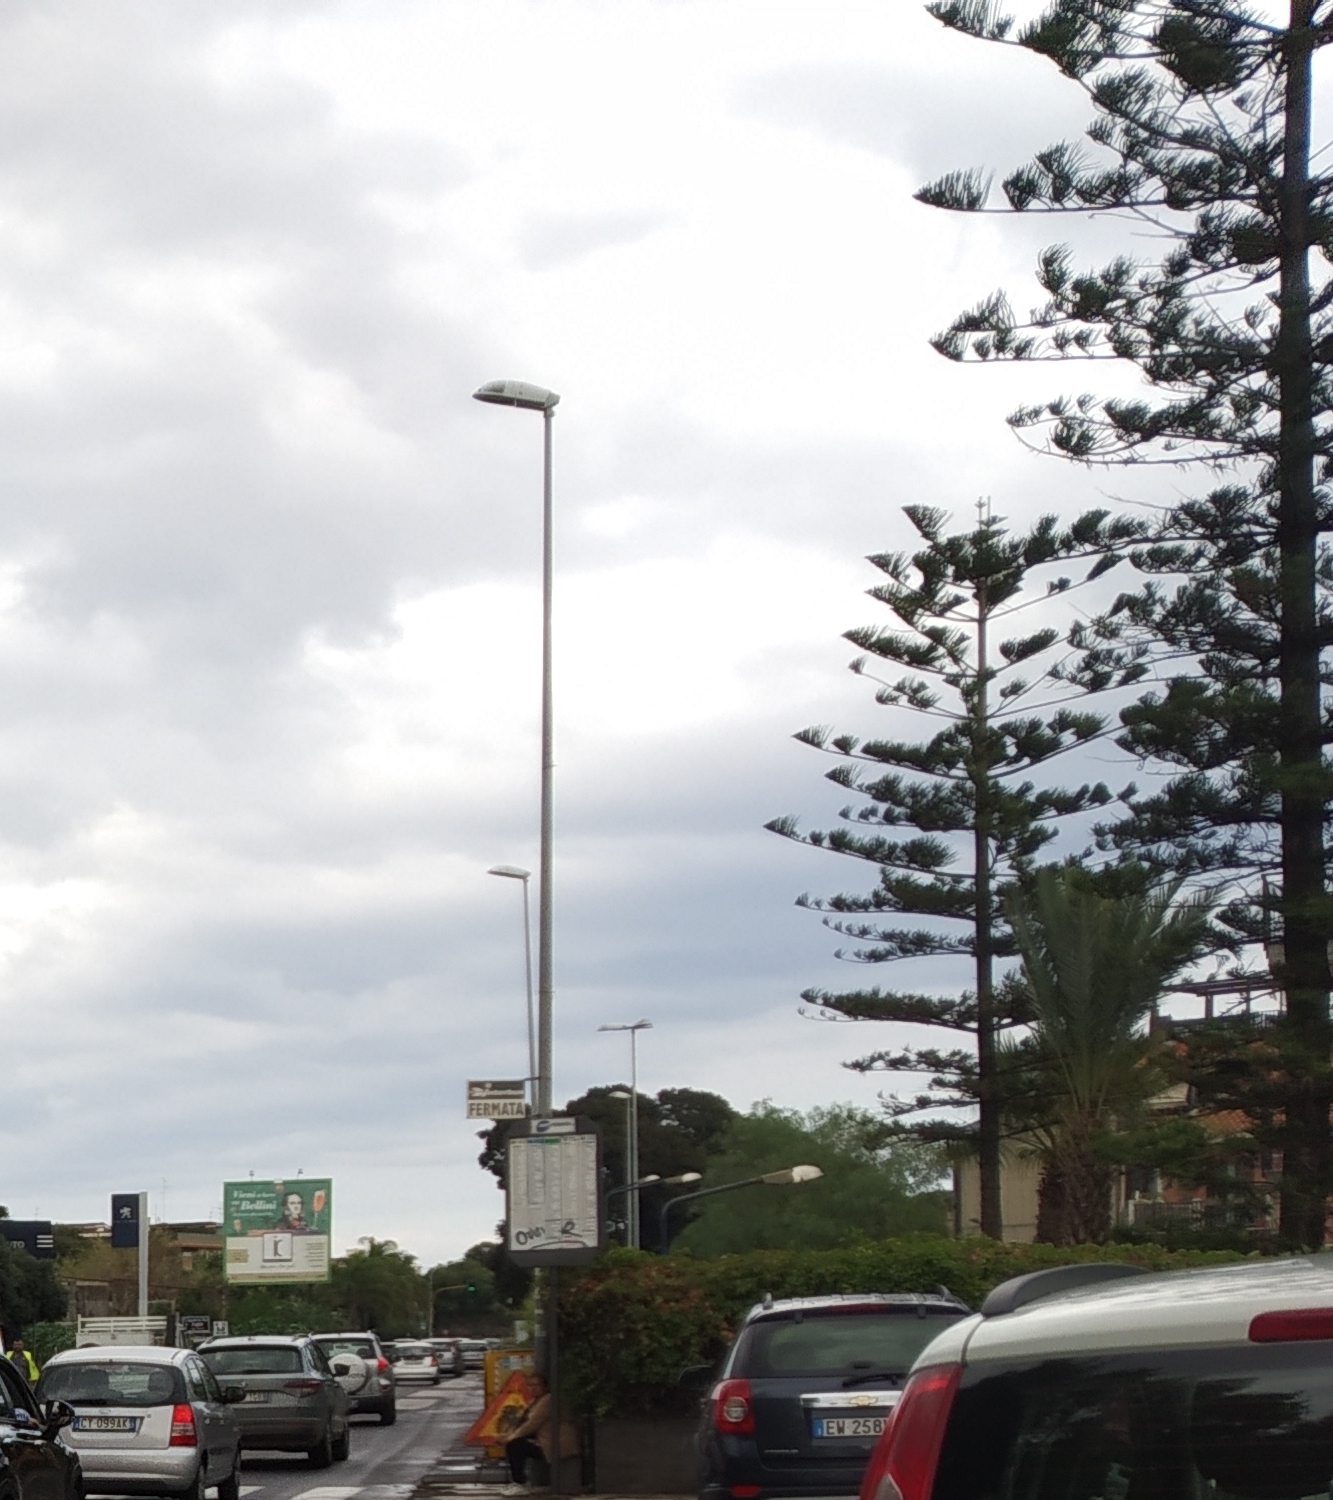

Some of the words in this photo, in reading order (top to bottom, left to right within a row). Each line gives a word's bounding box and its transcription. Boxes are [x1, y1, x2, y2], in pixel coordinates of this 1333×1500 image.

[469, 1102, 524, 1116] FERMATA
[826, 1420, 846, 1435] EW
[852, 1419, 887, 1434] 258
